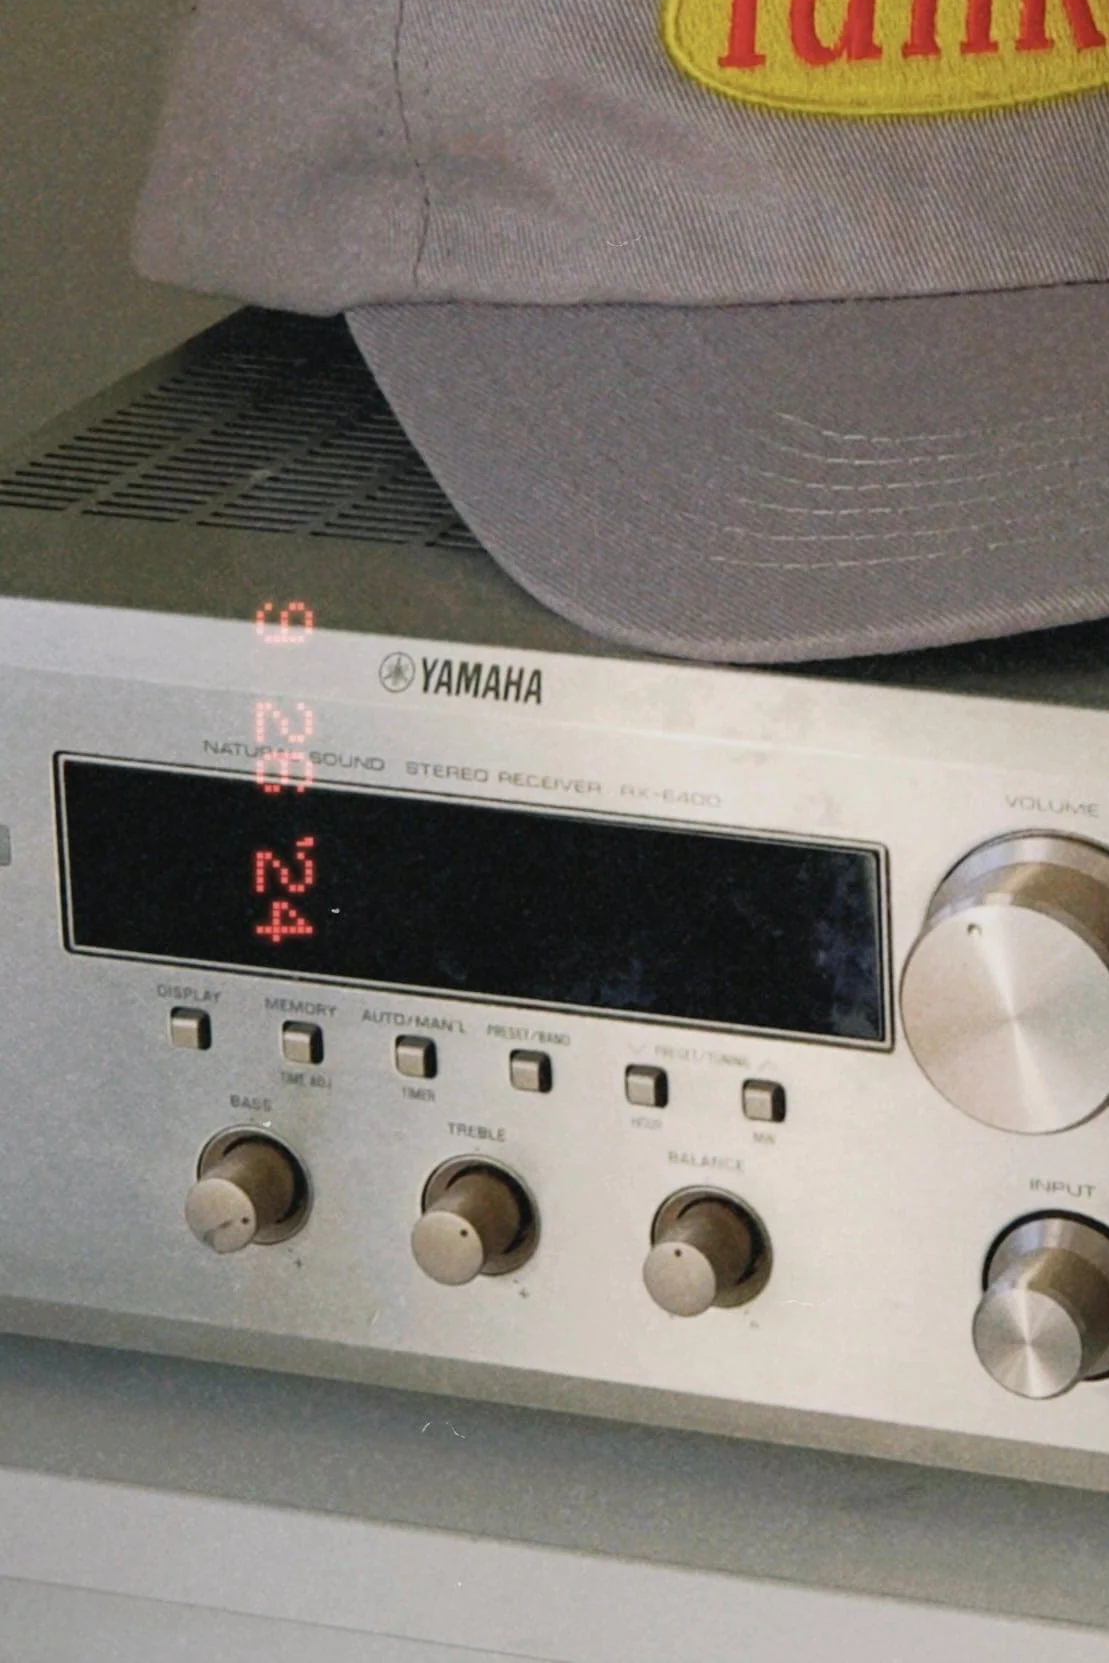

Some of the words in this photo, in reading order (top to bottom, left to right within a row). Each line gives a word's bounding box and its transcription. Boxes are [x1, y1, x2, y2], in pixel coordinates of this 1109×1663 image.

[421, 657, 543, 704] YAMAHA
[308, 750, 386, 772] SOUND
[405, 760, 489, 783] STEREO
[498, 771, 603, 794] RECEIVER
[1004, 793, 1100, 818] VOLUME
[157, 984, 221, 1003] DISPLAY
[265, 997, 337, 1017] MEMORY
[230, 1094, 273, 1112] BASS
[448, 1121, 507, 1143] TREBLE
[668, 1150, 746, 1174] BALANCE
[1029, 1178, 1097, 1199] INPUT
